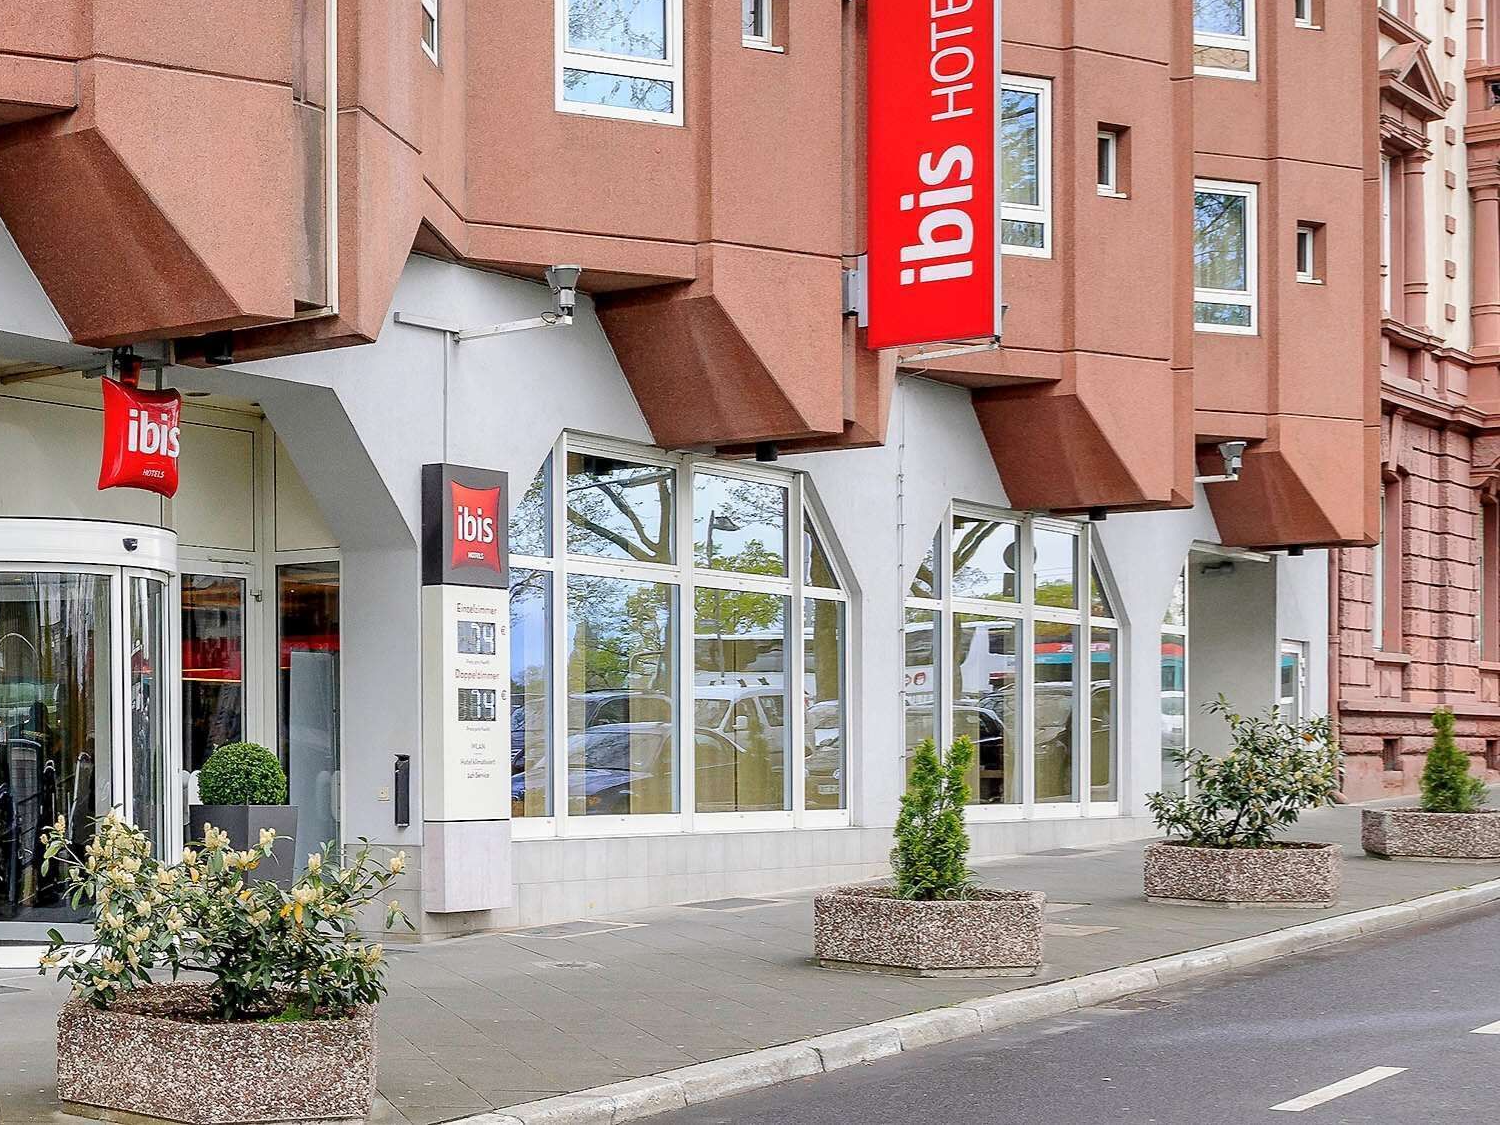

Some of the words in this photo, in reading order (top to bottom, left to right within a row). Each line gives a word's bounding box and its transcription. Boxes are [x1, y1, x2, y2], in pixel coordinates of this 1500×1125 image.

[900, 144, 974, 286] ibis
[128, 408, 180, 458] ibis
[142, 468, 165, 479] HOTELS
[457, 505, 494, 543] ibis
